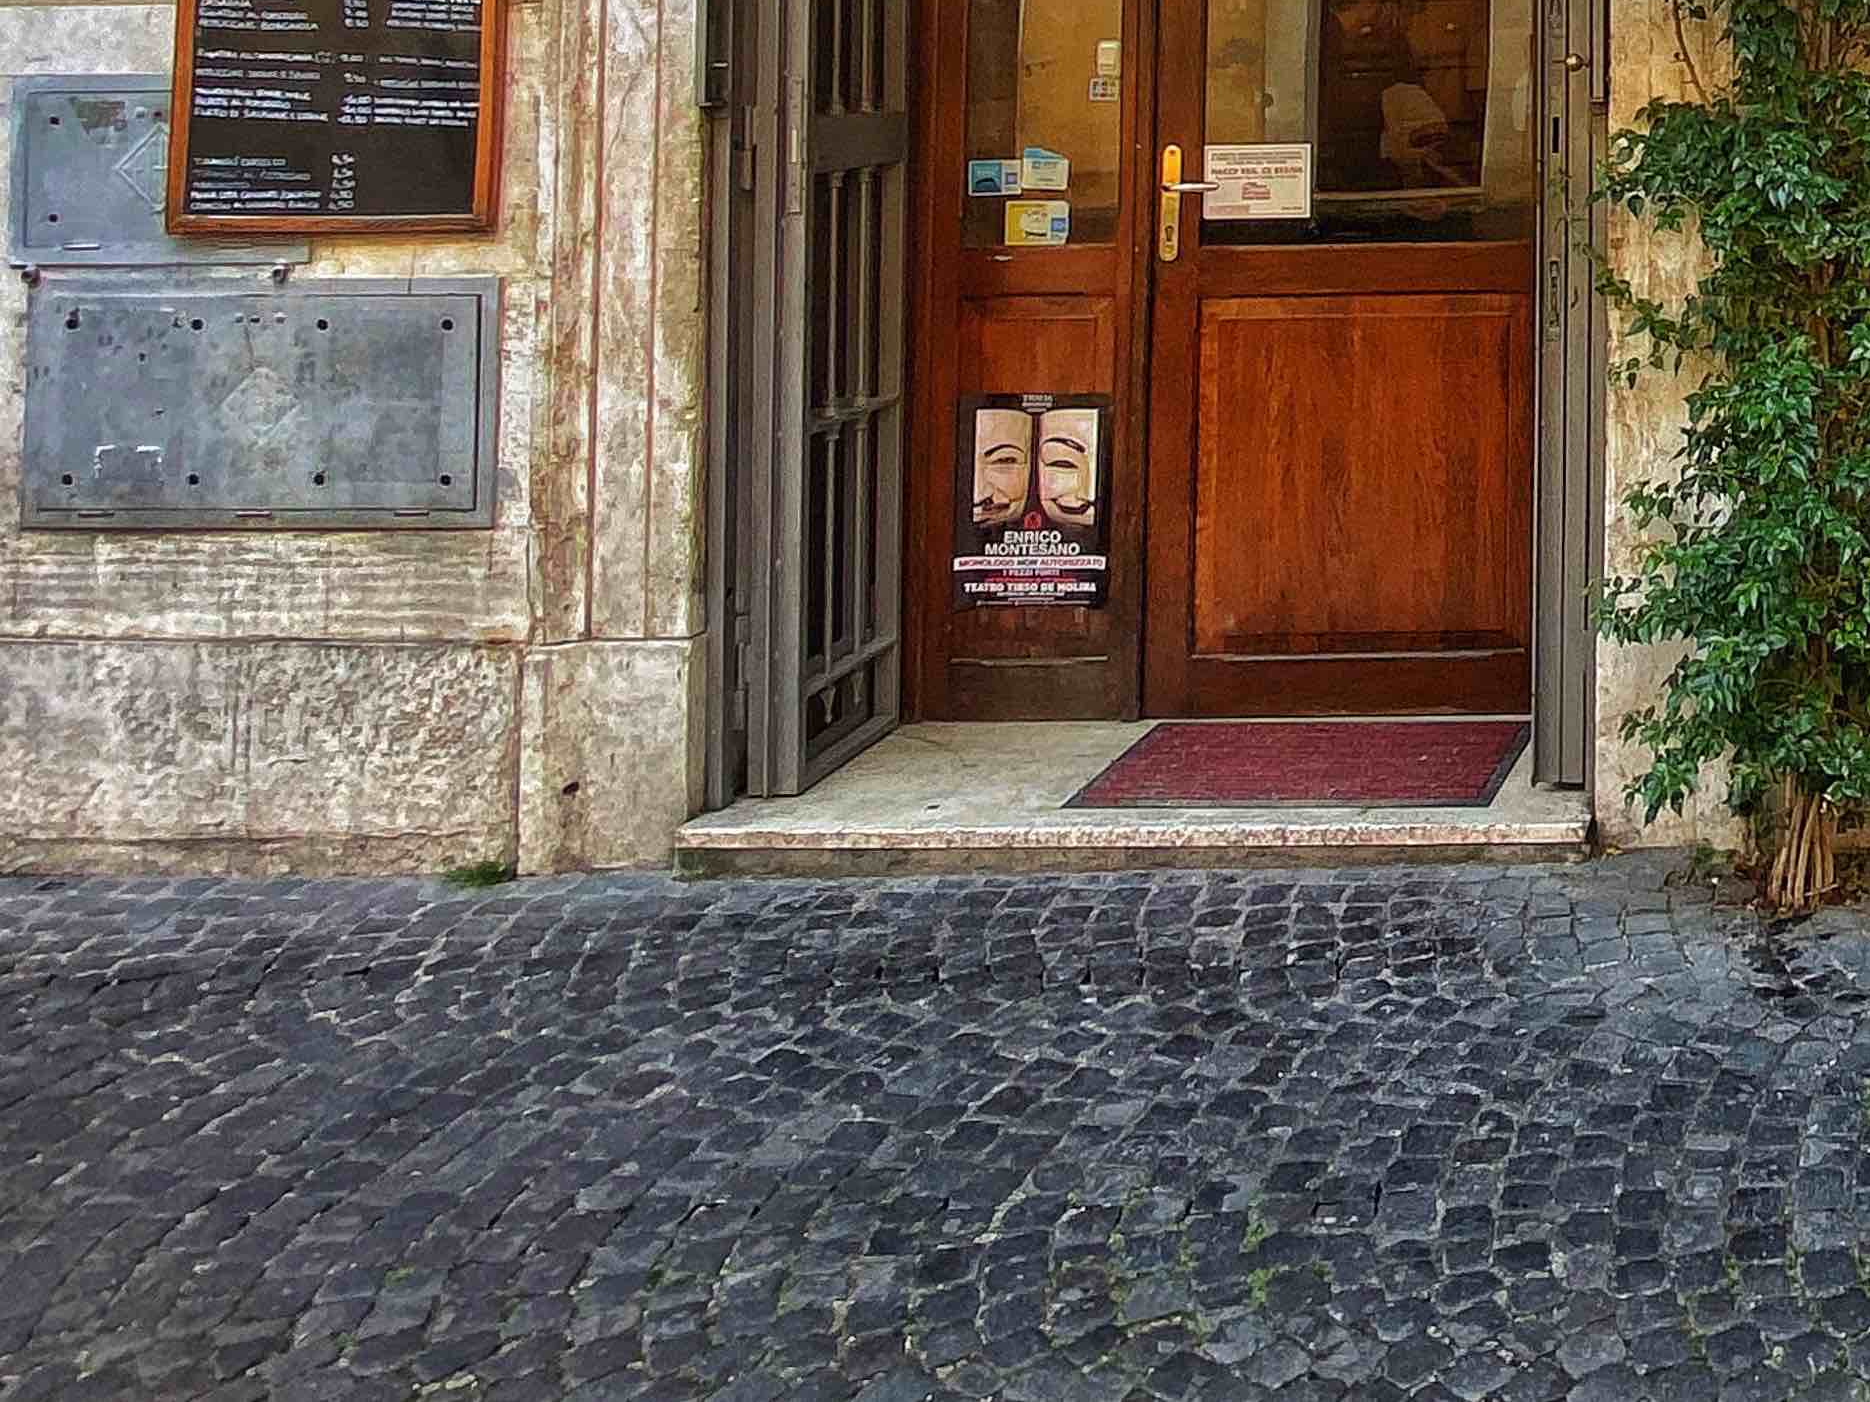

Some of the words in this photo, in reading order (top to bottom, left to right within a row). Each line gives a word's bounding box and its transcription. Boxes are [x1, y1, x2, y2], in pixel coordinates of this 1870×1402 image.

[1003, 530, 1062, 544] ENRICO
[984, 543, 1081, 556] MONTESANO
[964, 582, 1005, 593] TEATRO
